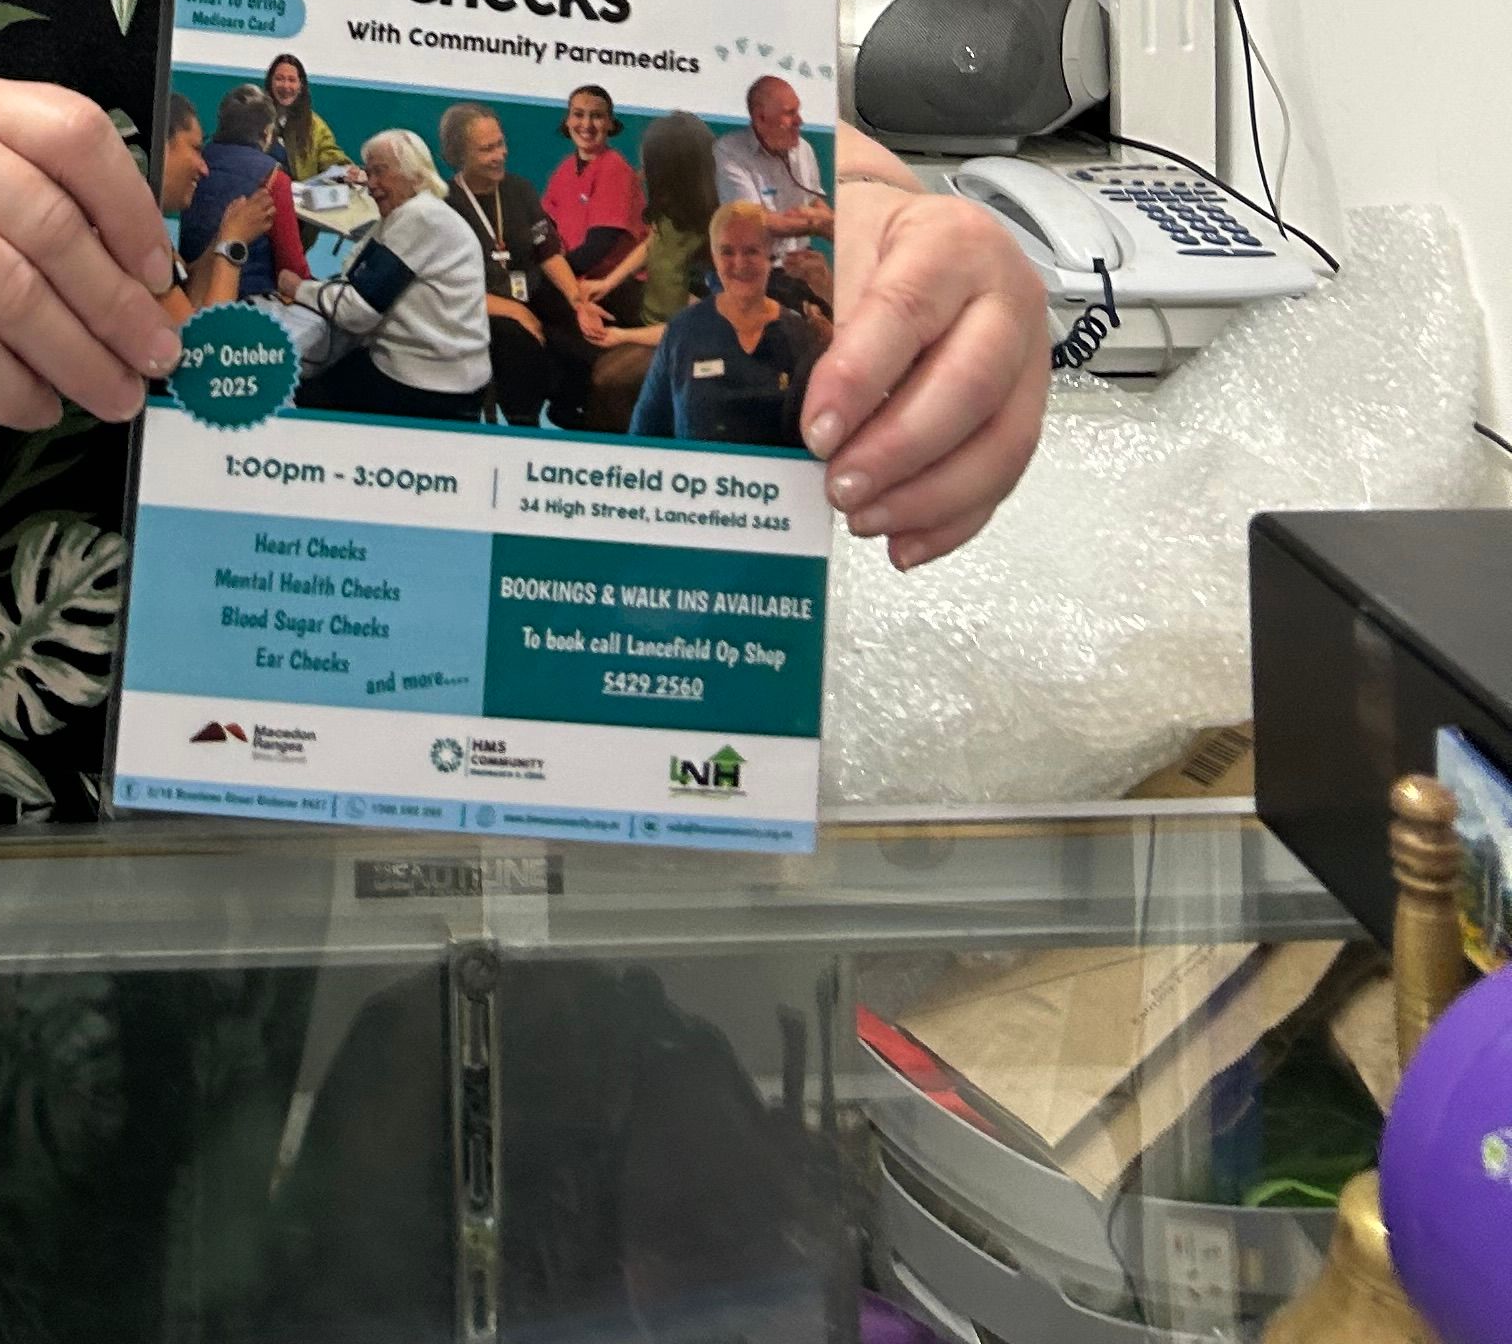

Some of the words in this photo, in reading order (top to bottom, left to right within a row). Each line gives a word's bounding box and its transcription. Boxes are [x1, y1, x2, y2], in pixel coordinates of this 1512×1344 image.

[192, 11, 245, 31] Medicare
[247, 15, 277, 34] Card
[348, 19, 401, 46] With
[408, 27, 548, 64] Community
[554, 41, 700, 74] Paramedics
[220, 342, 286, 367] October
[208, 375, 258, 398] 2025
[224, 454, 327, 485] 1:00pm
[353, 467, 459, 495] 3:00pm
[526, 461, 662, 493] Lancefield
[670, 473, 707, 500] Op
[714, 476, 780, 504] Shop
[519, 496, 541, 513] 34
[544, 498, 586, 519] High
[590, 502, 651, 524] Street,
[654, 507, 748, 529] Lancefield
[751, 515, 791, 532] 3435
[254, 533, 301, 557] Heart
[307, 538, 368, 562] Checks
[214, 568, 274, 594] Mental
[280, 573, 335, 598] Health
[339, 578, 401, 602] Checks
[500, 576, 597, 604] BOOKINGS
[602, 585, 615, 607] &
[620, 585, 672, 610] WALK
[676, 589, 710, 613] INS
[713, 593, 813, 621] AVAILABLE
[220, 605, 270, 630] Blood
[274, 611, 324, 639] Sugar
[328, 615, 389, 640] Checks
[255, 647, 286, 670] Ear
[289, 651, 350, 675] Checks
[522, 626, 541, 649] To
[544, 629, 585, 654] book
[590, 632, 620, 656] call
[626, 635, 711, 663] Lancefield
[715, 642, 739, 666] Op
[744, 644, 787, 673] Shop
[602, 670, 652, 696] 5429
[656, 675, 704, 699] 2560
[252, 736, 305, 754] Ranges
[253, 722, 318, 743] Macedon
[470, 737, 507, 756] HMS
[470, 754, 545, 771] COMMUNITY
